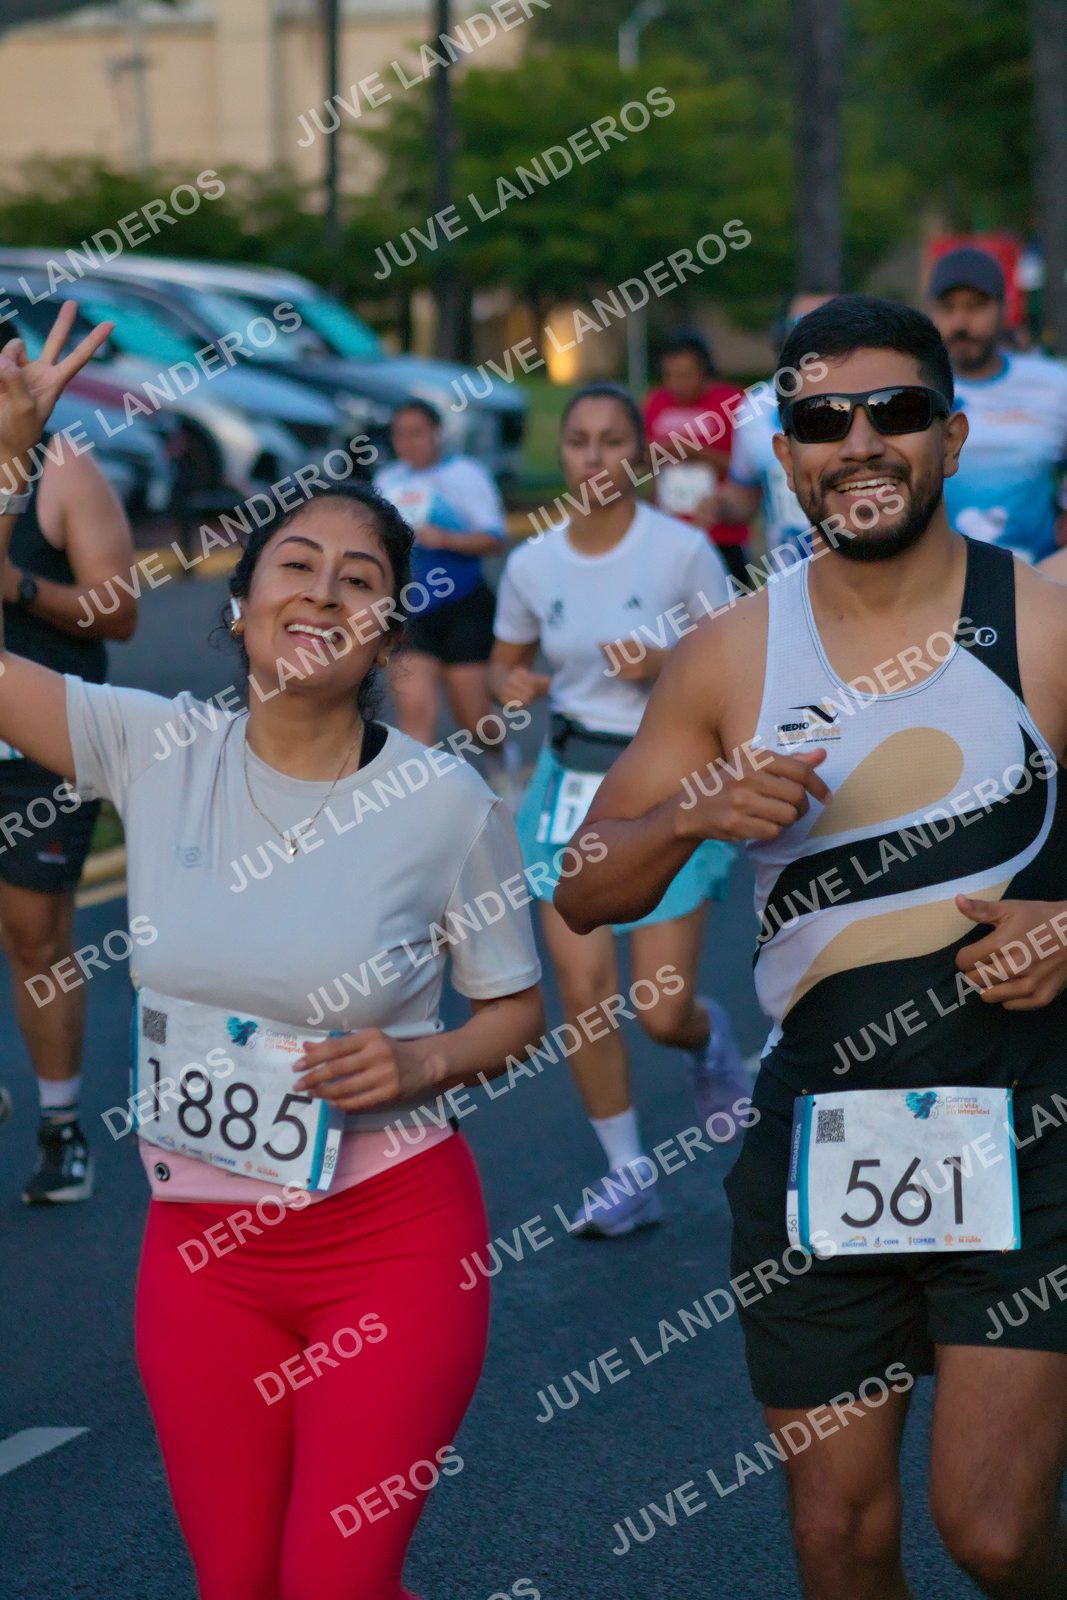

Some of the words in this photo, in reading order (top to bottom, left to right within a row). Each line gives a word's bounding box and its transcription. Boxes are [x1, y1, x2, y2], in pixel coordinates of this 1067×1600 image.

[777, 722, 809, 733] MEDIO
[148, 1057, 313, 1162] 1885
[841, 1157, 963, 1228] 561
[788, 1213, 798, 1233] 561
